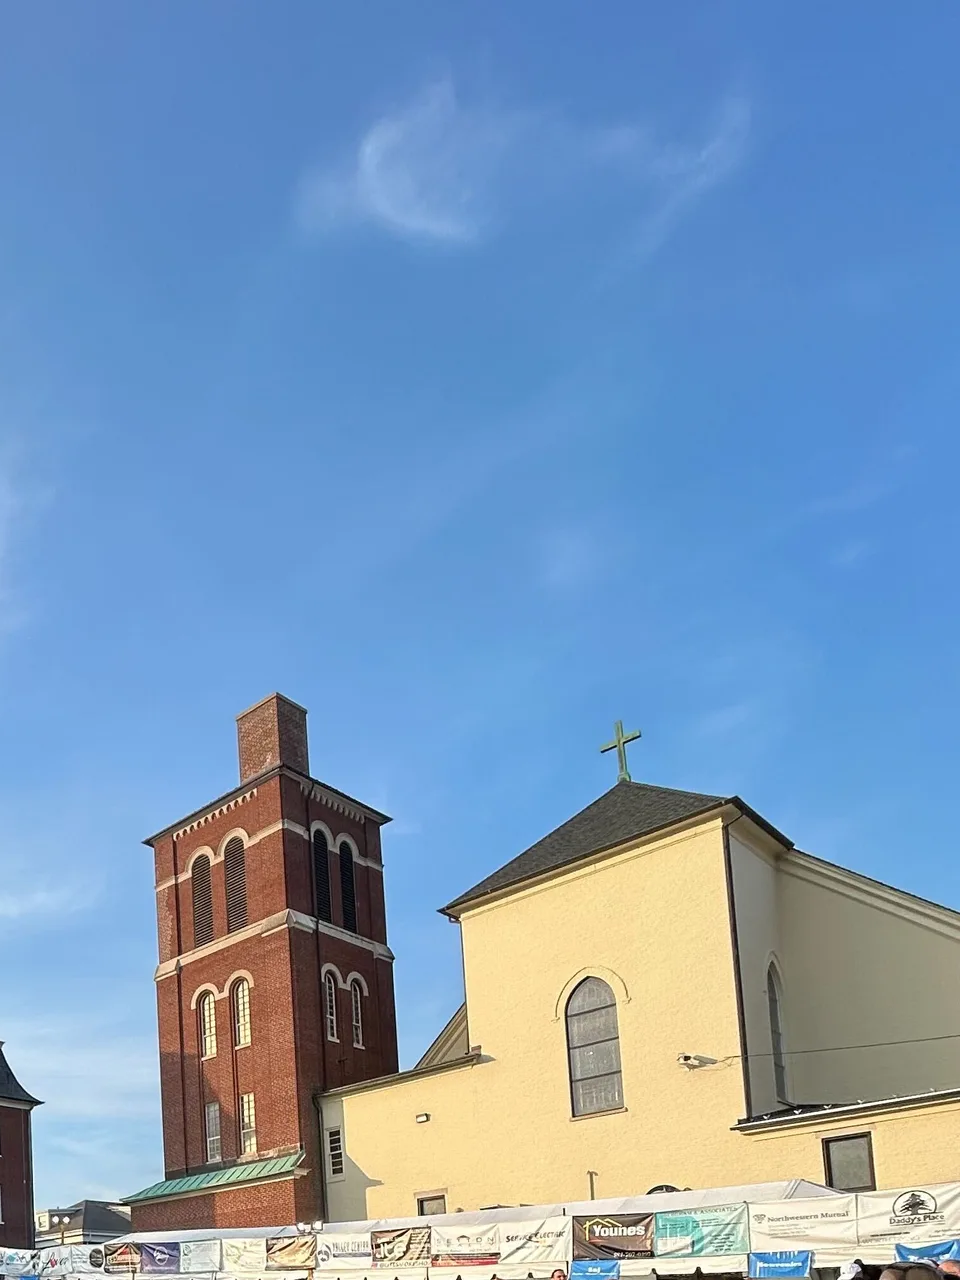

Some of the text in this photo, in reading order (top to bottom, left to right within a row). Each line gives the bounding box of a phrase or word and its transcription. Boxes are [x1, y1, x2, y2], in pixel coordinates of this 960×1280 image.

[767, 1211, 849, 1223] Northwestern Mutual
[889, 1214, 945, 1225] Daddy's Place
[593, 1225, 645, 1237] Younes
